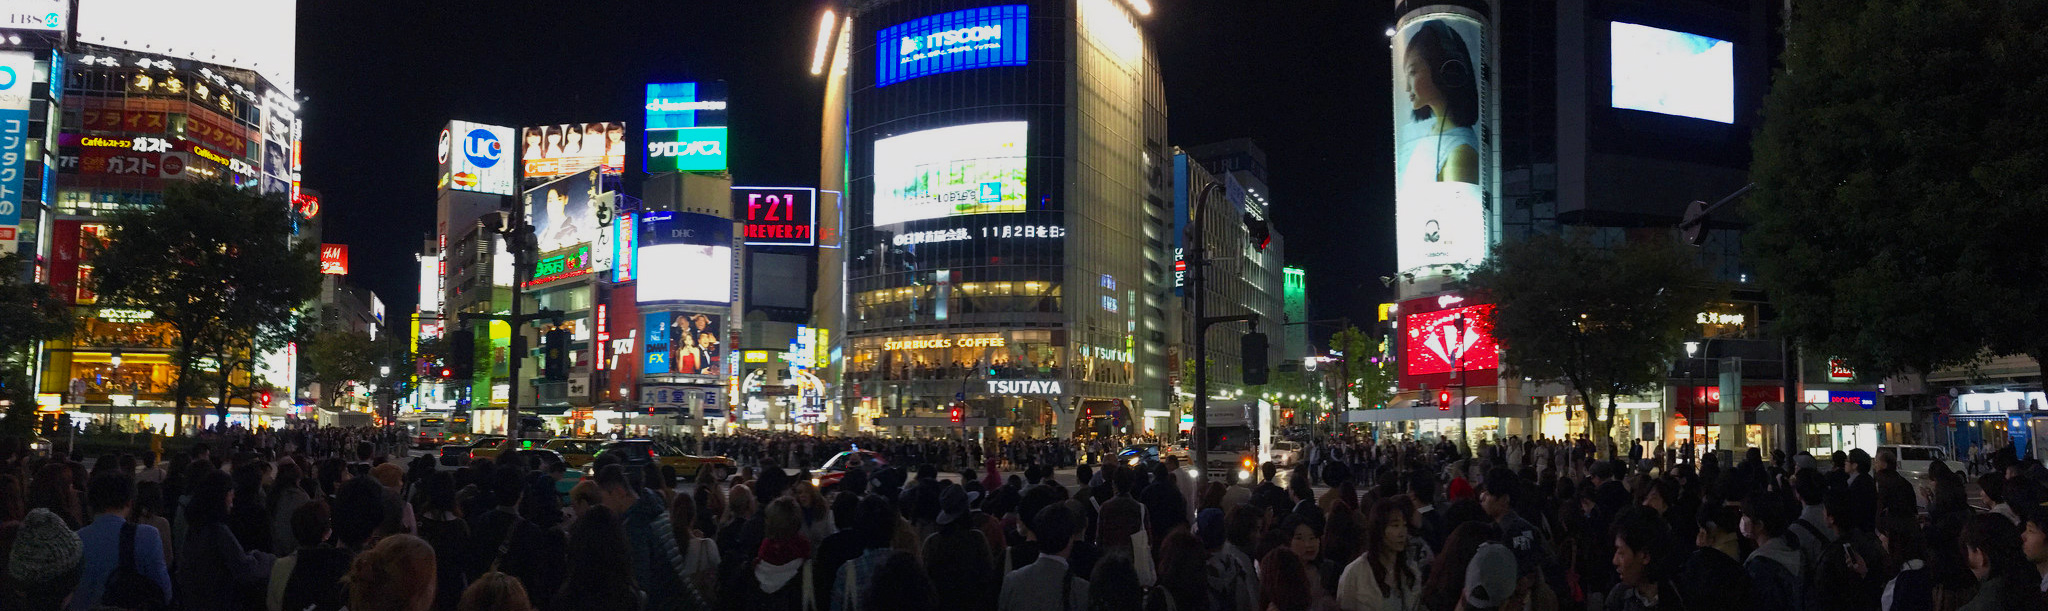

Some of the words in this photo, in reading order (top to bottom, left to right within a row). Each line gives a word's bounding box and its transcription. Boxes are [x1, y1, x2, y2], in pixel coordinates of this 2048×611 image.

[188, 117, 245, 151] コンタクト
[132, 137, 173, 153] ガスト
[648, 140, 722, 157] サロンパス
[60, 156, 80, 168] 7F
[107, 155, 156, 175] ガスト
[748, 193, 793, 221] F21
[672, 228, 695, 238] DHC
[744, 224, 793, 238] OREVER
[795, 225, 810, 239] 21
[885, 339, 951, 351] STARBUCKS
[958, 337, 1005, 348] COFFEE
[649, 353, 664, 363] FX
[987, 380, 1062, 394] TSUTAYA
[645, 389, 716, 405] 大盛堂店
